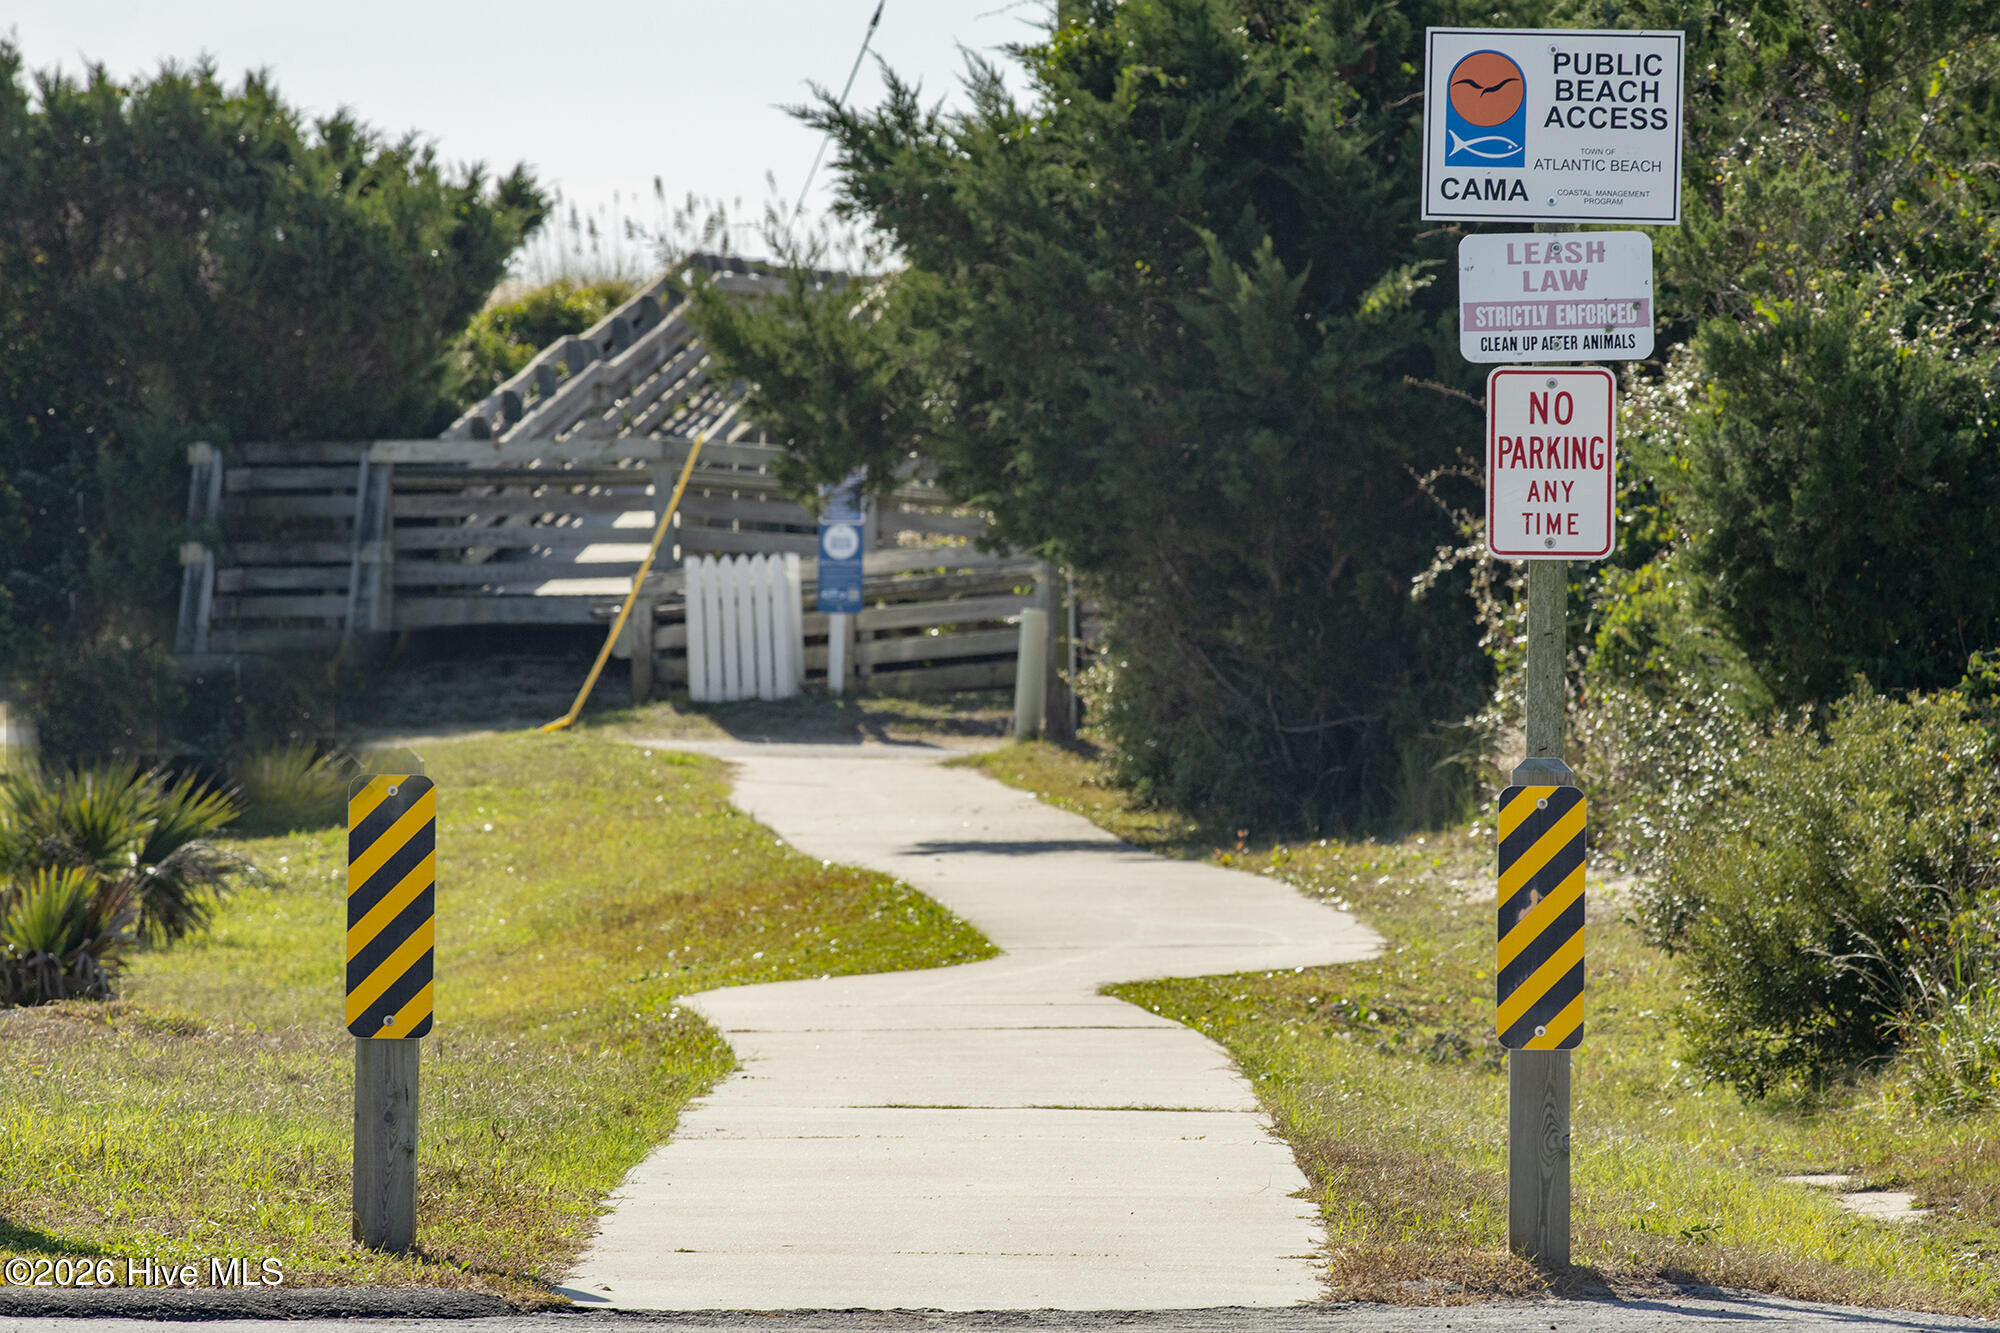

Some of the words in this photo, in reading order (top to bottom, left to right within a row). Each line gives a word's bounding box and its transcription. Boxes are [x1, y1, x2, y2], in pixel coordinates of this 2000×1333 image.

[1553, 52, 1663, 76] PUBLIC
[1555, 79, 1659, 103] BEACH
[1544, 106, 1668, 130] ACCESS
[1533, 158, 1606, 172] ATLANTIC
[1610, 160, 1662, 172] BEACH
[1440, 178, 1529, 201] CAMA
[1557, 189, 1592, 197] COASTAL
[1595, 190, 1650, 198] MANAGEMENT
[1583, 198, 1624, 206] PROGRAM
[1507, 241, 1605, 265] LEASH
[1523, 269, 1588, 292] LAW
[1475, 305, 1548, 328] STRICTLY
[1556, 302, 1638, 326] ENFORCED
[1481, 336, 1517, 352] CLEAN
[1522, 336, 1538, 351] UP
[1583, 334, 1636, 350] ANIMALS
[1529, 391, 1574, 425] NO
[1498, 436, 1604, 470] PARKING
[1527, 480, 1575, 503] ANY
[1522, 512, 1579, 535] TIME
